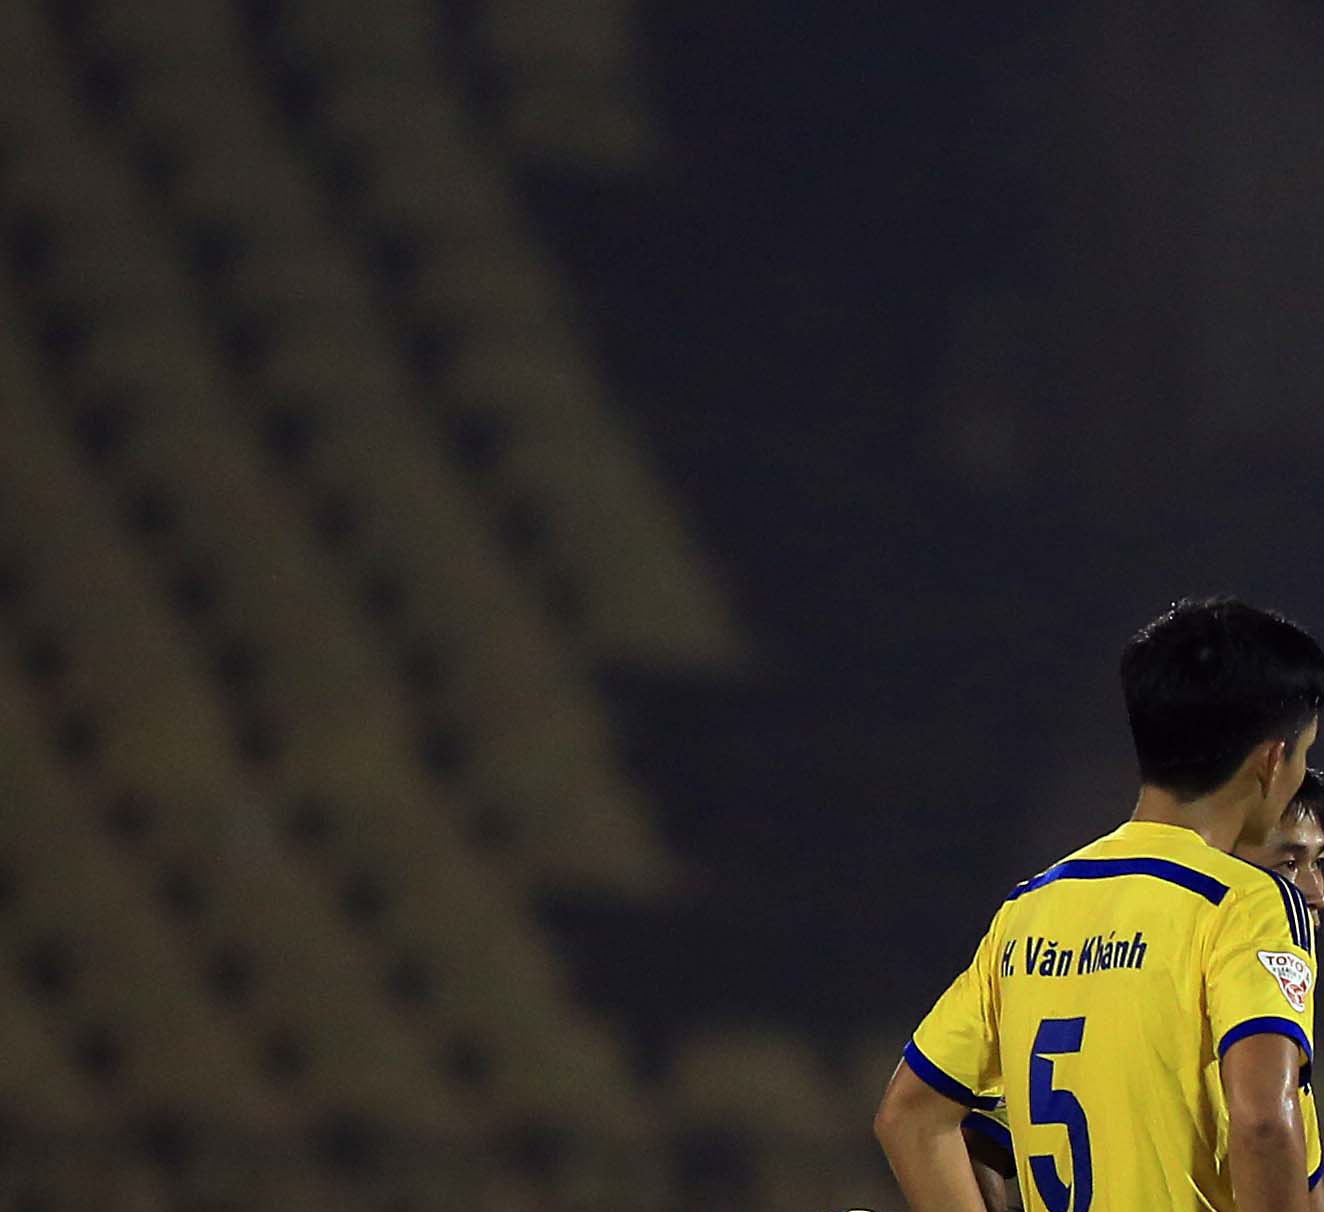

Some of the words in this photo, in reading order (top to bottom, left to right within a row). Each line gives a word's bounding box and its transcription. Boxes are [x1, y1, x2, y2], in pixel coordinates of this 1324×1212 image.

[1025, 936, 1074, 977] Văn
[1077, 930, 1148, 976] Khánh
[1265, 955, 1311, 984] TOYO
